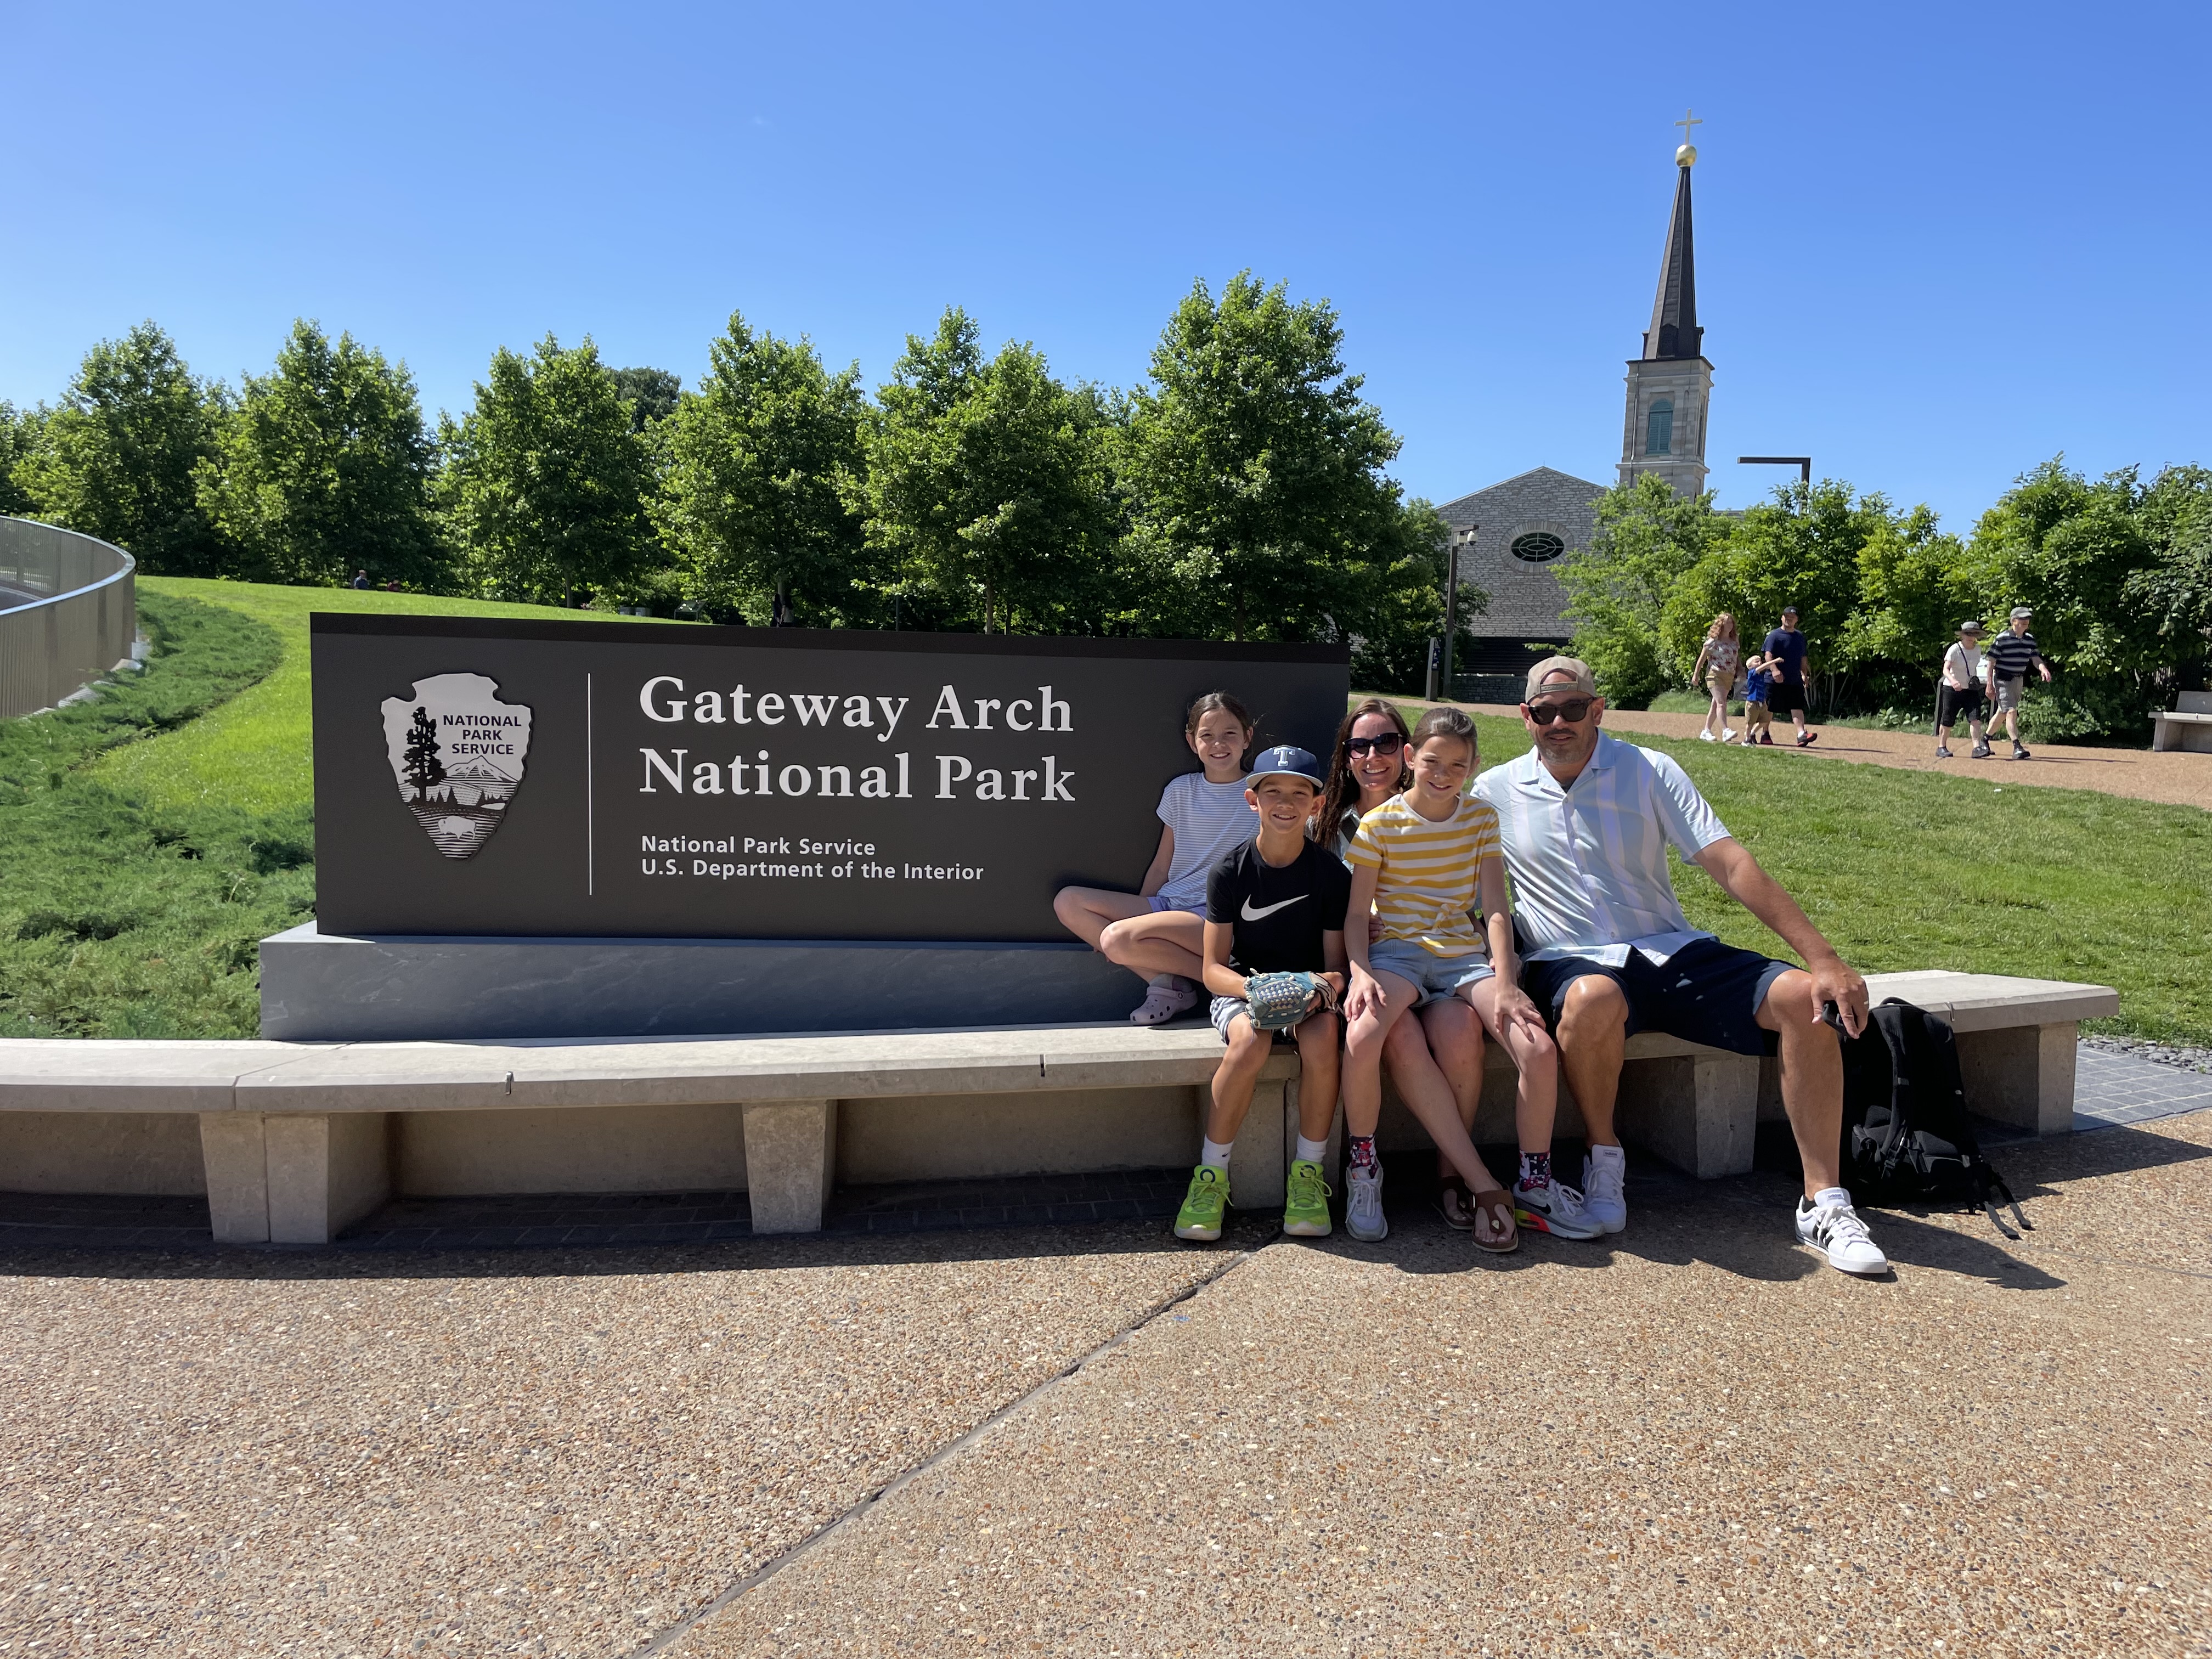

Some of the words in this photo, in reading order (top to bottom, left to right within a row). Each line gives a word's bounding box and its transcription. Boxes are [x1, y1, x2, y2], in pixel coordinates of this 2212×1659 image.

[640, 676, 909, 742] Gateway
[925, 685, 1074, 731] Arch
[443, 715, 522, 727] NATIONAL
[462, 729, 503, 741] PARK
[452, 743, 514, 755] SERVICE
[1273, 747, 1295, 766] T
[639, 748, 913, 798] National
[935, 755, 1076, 801] Park
[642, 835, 735, 853] National
[744, 837, 791, 854] Park
[799, 838, 875, 855] Service
[642, 859, 683, 875] U.S.
[693, 859, 823, 880] Department
[831, 861, 854, 878] of
[861, 861, 896, 878] the
[904, 863, 984, 880] Interior
